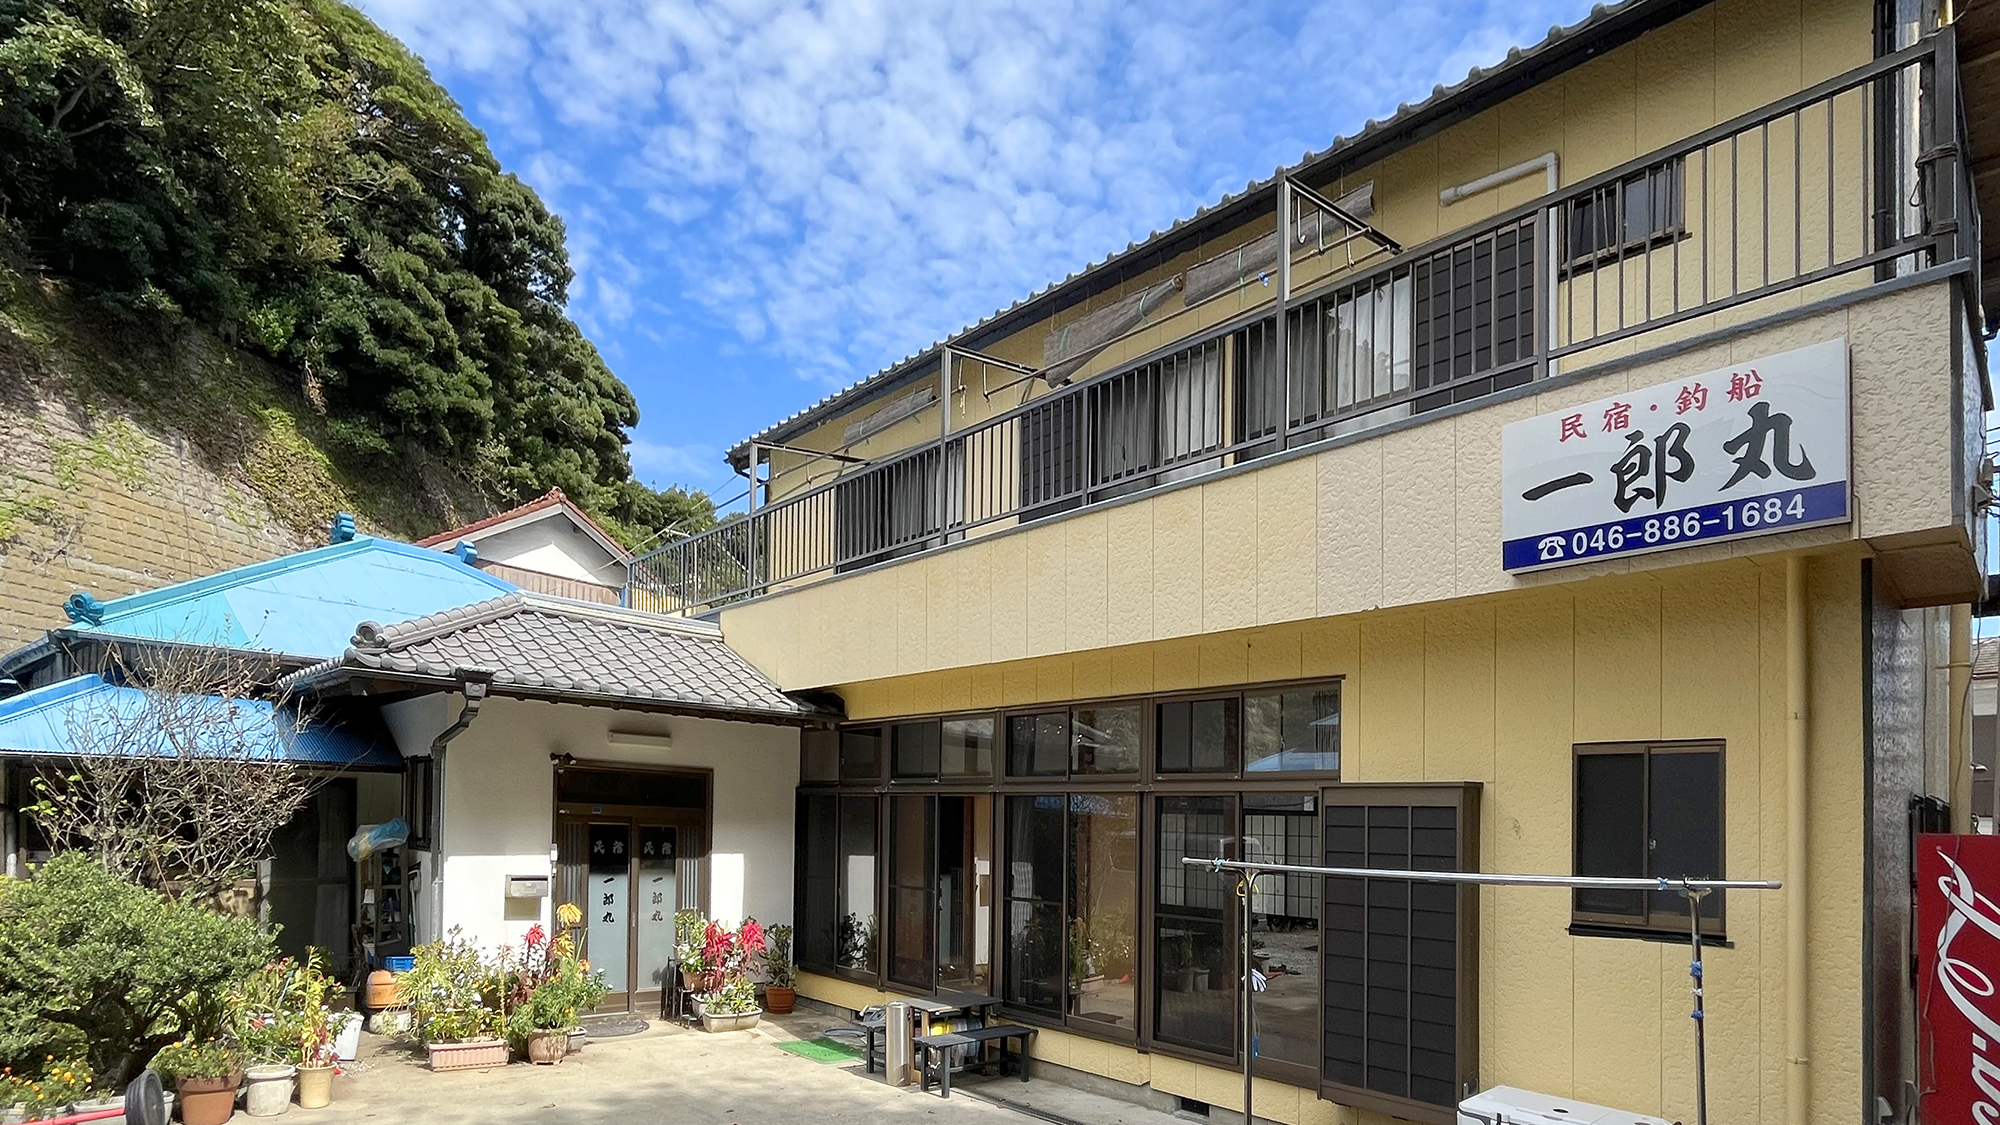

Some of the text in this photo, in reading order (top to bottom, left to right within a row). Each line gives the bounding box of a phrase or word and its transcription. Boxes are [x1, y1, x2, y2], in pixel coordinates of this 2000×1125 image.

[1559, 369, 1764, 442] 民宿・釣船
[1522, 401, 1817, 513] 一郎丸
[1572, 494, 1806, 556] 046-886-1684
[593, 839, 625, 855] 民宿
[643, 840, 673, 856] 民宿
[602, 876, 615, 923] 一郎丸
[651, 876, 664, 922] 一郎丸
